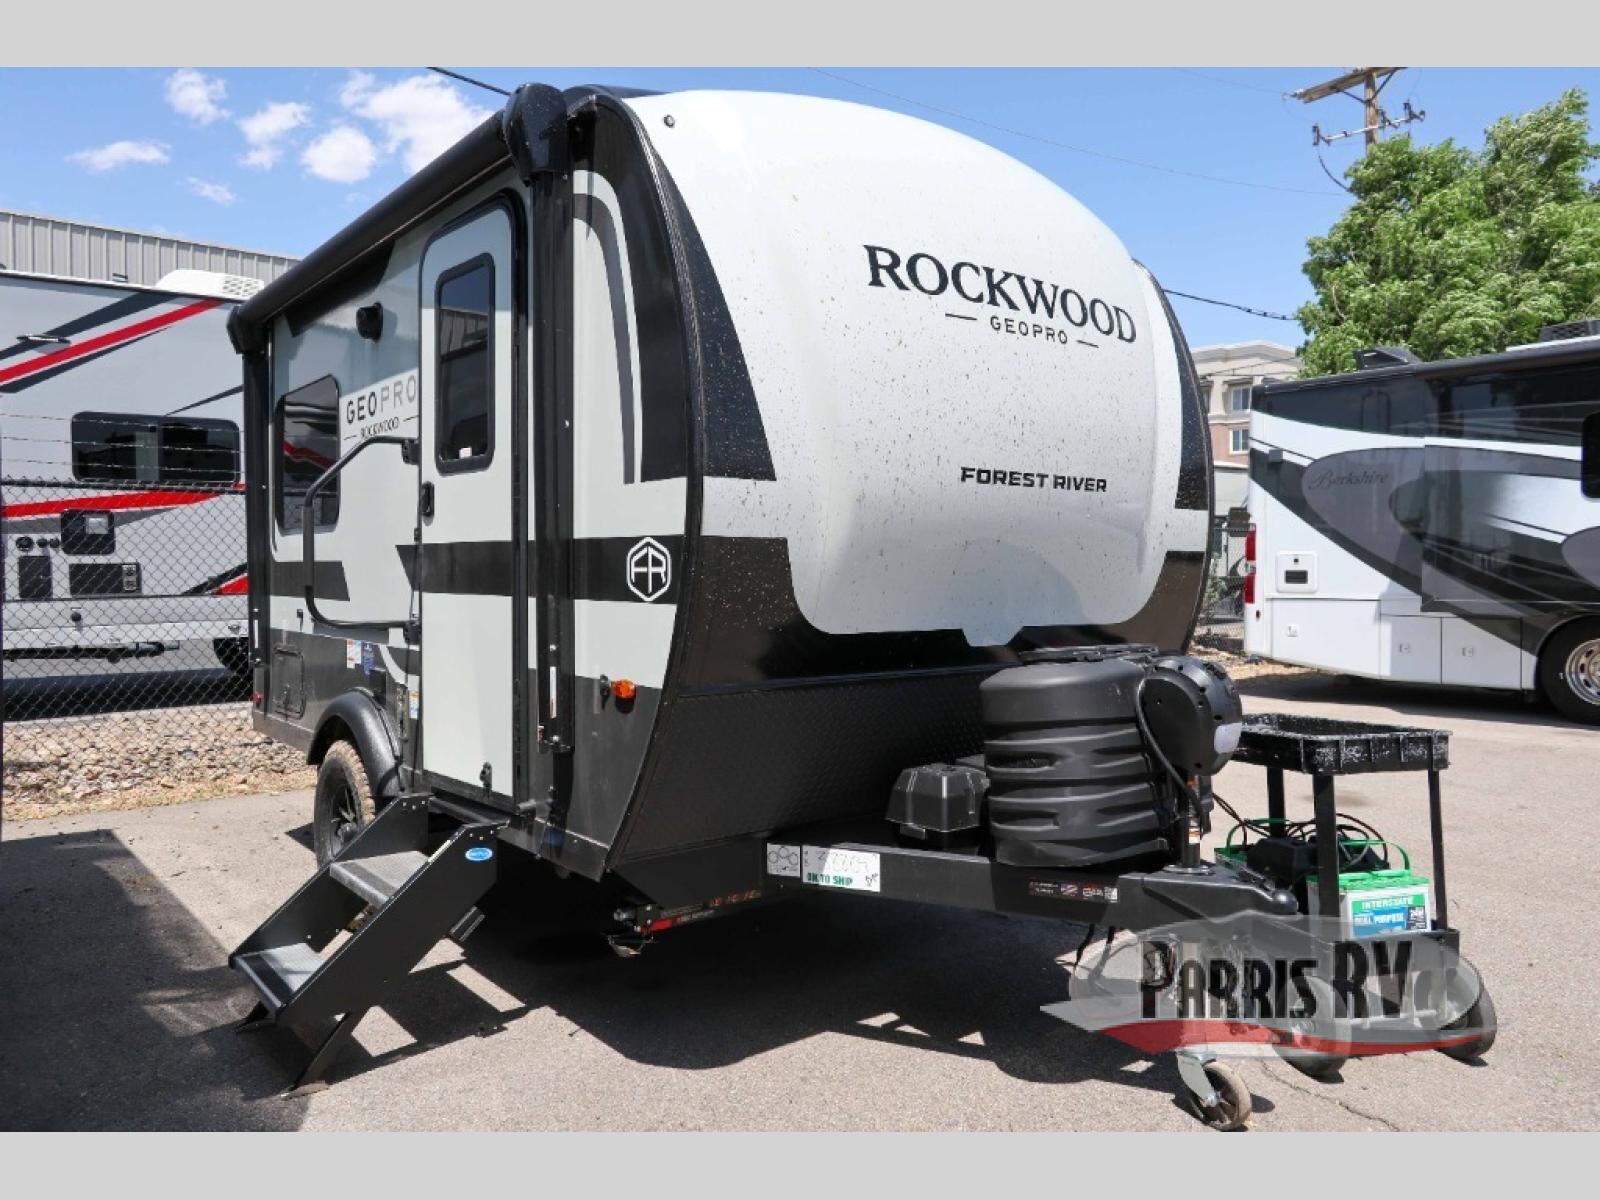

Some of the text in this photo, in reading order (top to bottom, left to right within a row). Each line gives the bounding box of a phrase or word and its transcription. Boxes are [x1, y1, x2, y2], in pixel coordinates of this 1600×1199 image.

[863, 244, 1137, 344] ROCKWOOD
[990, 316, 1068, 345] GEOPRO
[346, 375, 417, 425] GEOPRO
[360, 416, 400, 439] ROCKWOOD
[960, 466, 1107, 492] FOREST RIVER
[1308, 469, 1389, 490] Berkshire
[820, 874, 831, 884] TO
[832, 876, 853, 886] SHIP
[1361, 896, 1413, 910] INTERSTATE
